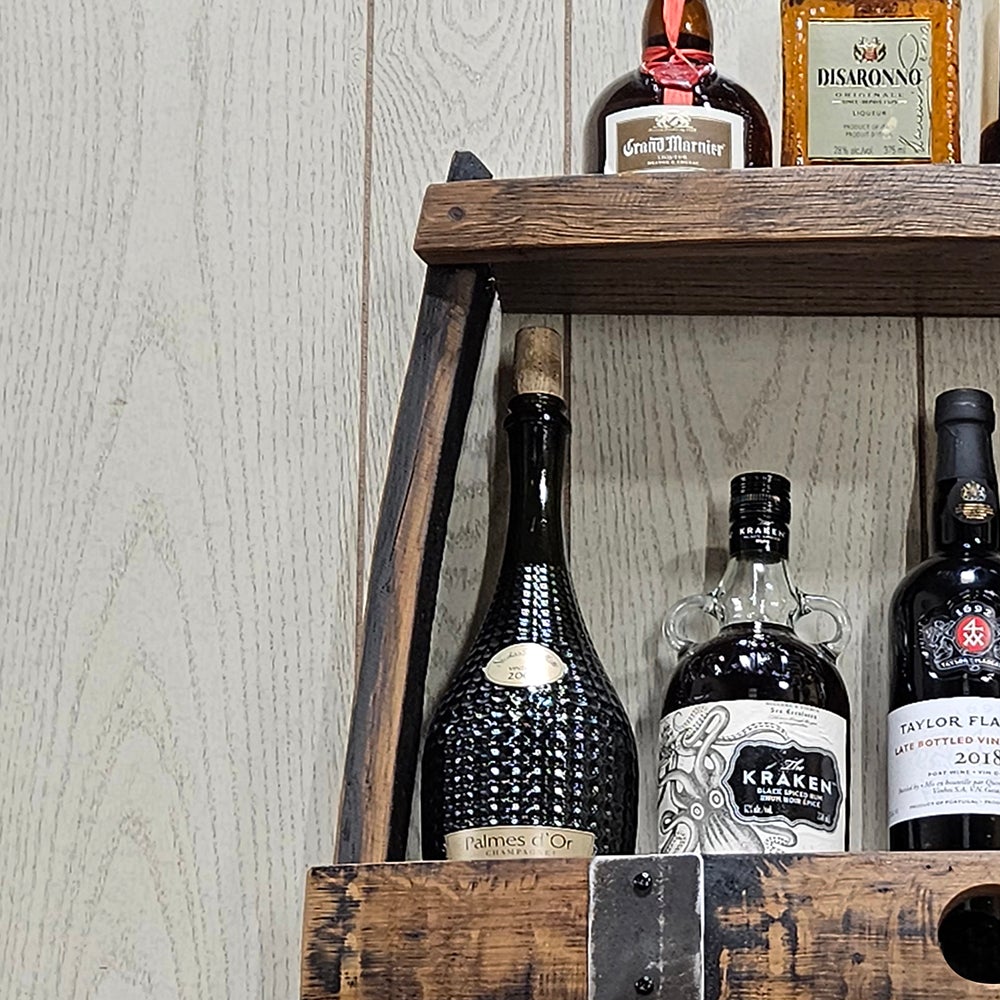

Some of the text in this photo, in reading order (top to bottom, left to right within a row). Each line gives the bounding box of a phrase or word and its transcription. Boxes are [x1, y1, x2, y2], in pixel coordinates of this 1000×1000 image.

[818, 68, 921, 88] DISARONNO
[623, 135, 725, 157] Grand Marnier
[739, 526, 785, 538] KRAKEN
[900, 716, 963, 735] TAYLOR
[895, 742, 915, 756] LATE
[918, 736, 973, 747] BOTTLED
[742, 770, 833, 795] KRAKEN
[465, 833, 573, 850] Palmes d'Or
